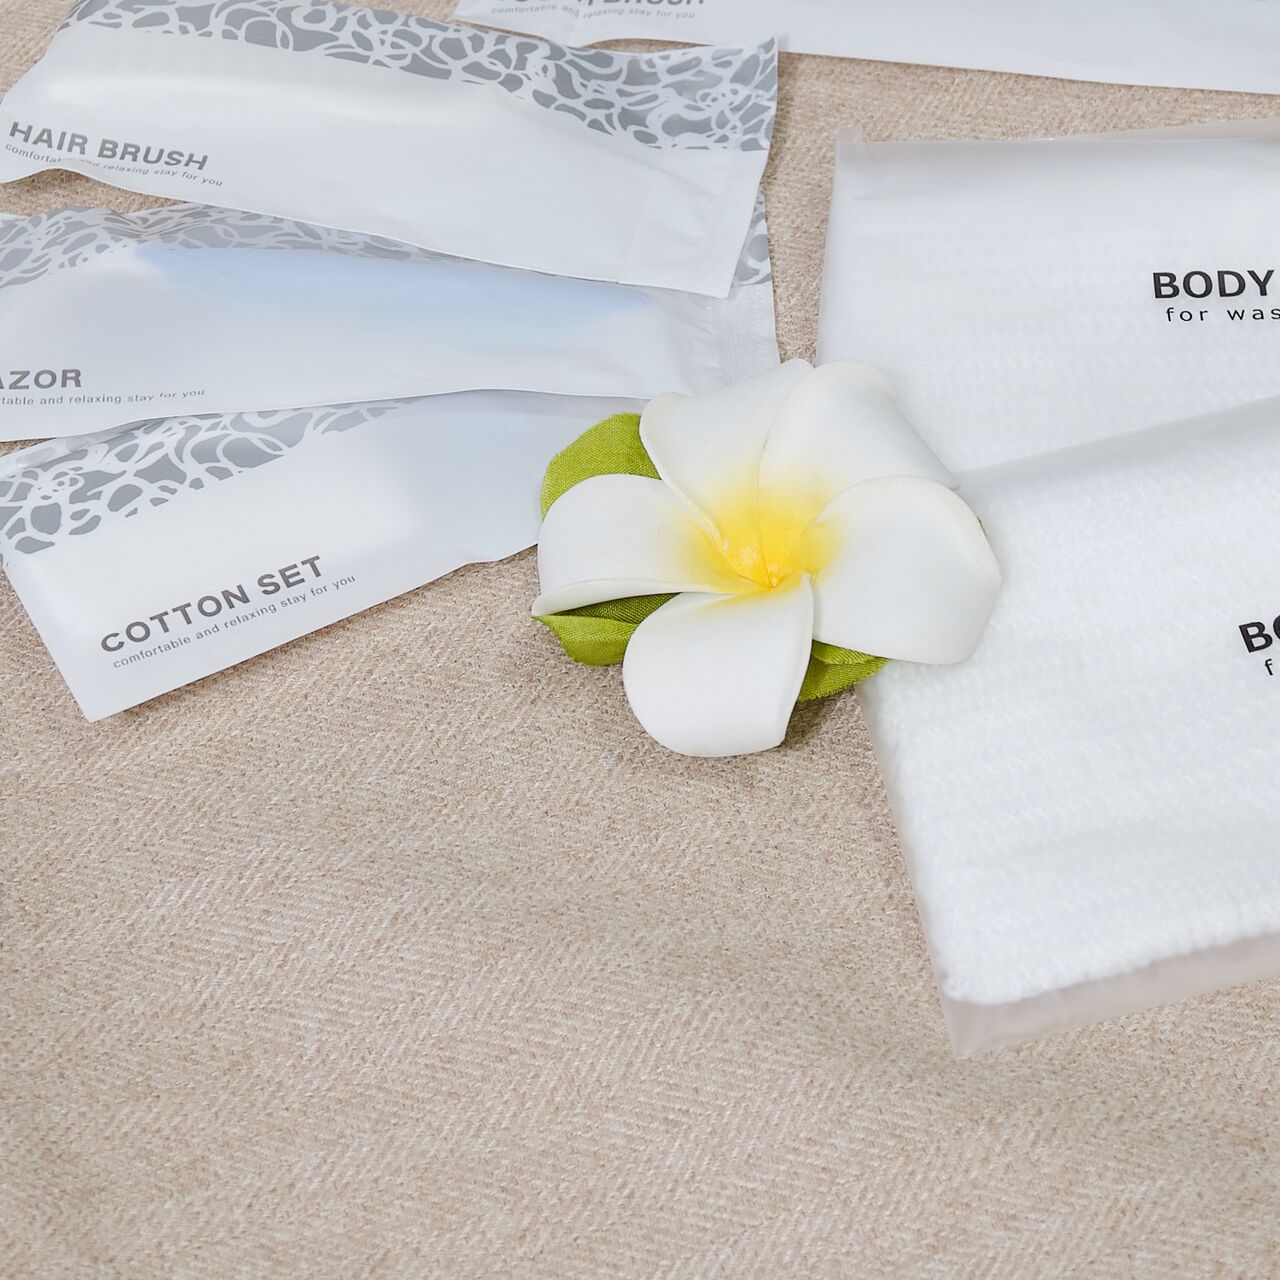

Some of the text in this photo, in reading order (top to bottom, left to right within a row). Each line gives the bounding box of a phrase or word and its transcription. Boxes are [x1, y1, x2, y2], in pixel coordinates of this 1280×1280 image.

[490, 3, 558, 15] comfortable
[628, 7, 653, 18] stay
[656, 8, 672, 18] for
[675, 11, 697, 21] you
[9, 121, 209, 172] HAIR BRUSH
[103, 163, 151, 176] relaxing
[153, 167, 179, 178] stay
[181, 170, 200, 182] for
[200, 176, 224, 188] you
[1151, 269, 1276, 300] BODY
[1165, 306, 1210, 322] for
[39, 395, 64, 406] and
[69, 392, 122, 406] relaxing
[127, 391, 155, 404] stay
[159, 390, 178, 400] for
[181, 388, 206, 399] you
[100, 554, 326, 653] COTTON SET
[112, 574, 357, 670] comfortable and relaxing stay for you
